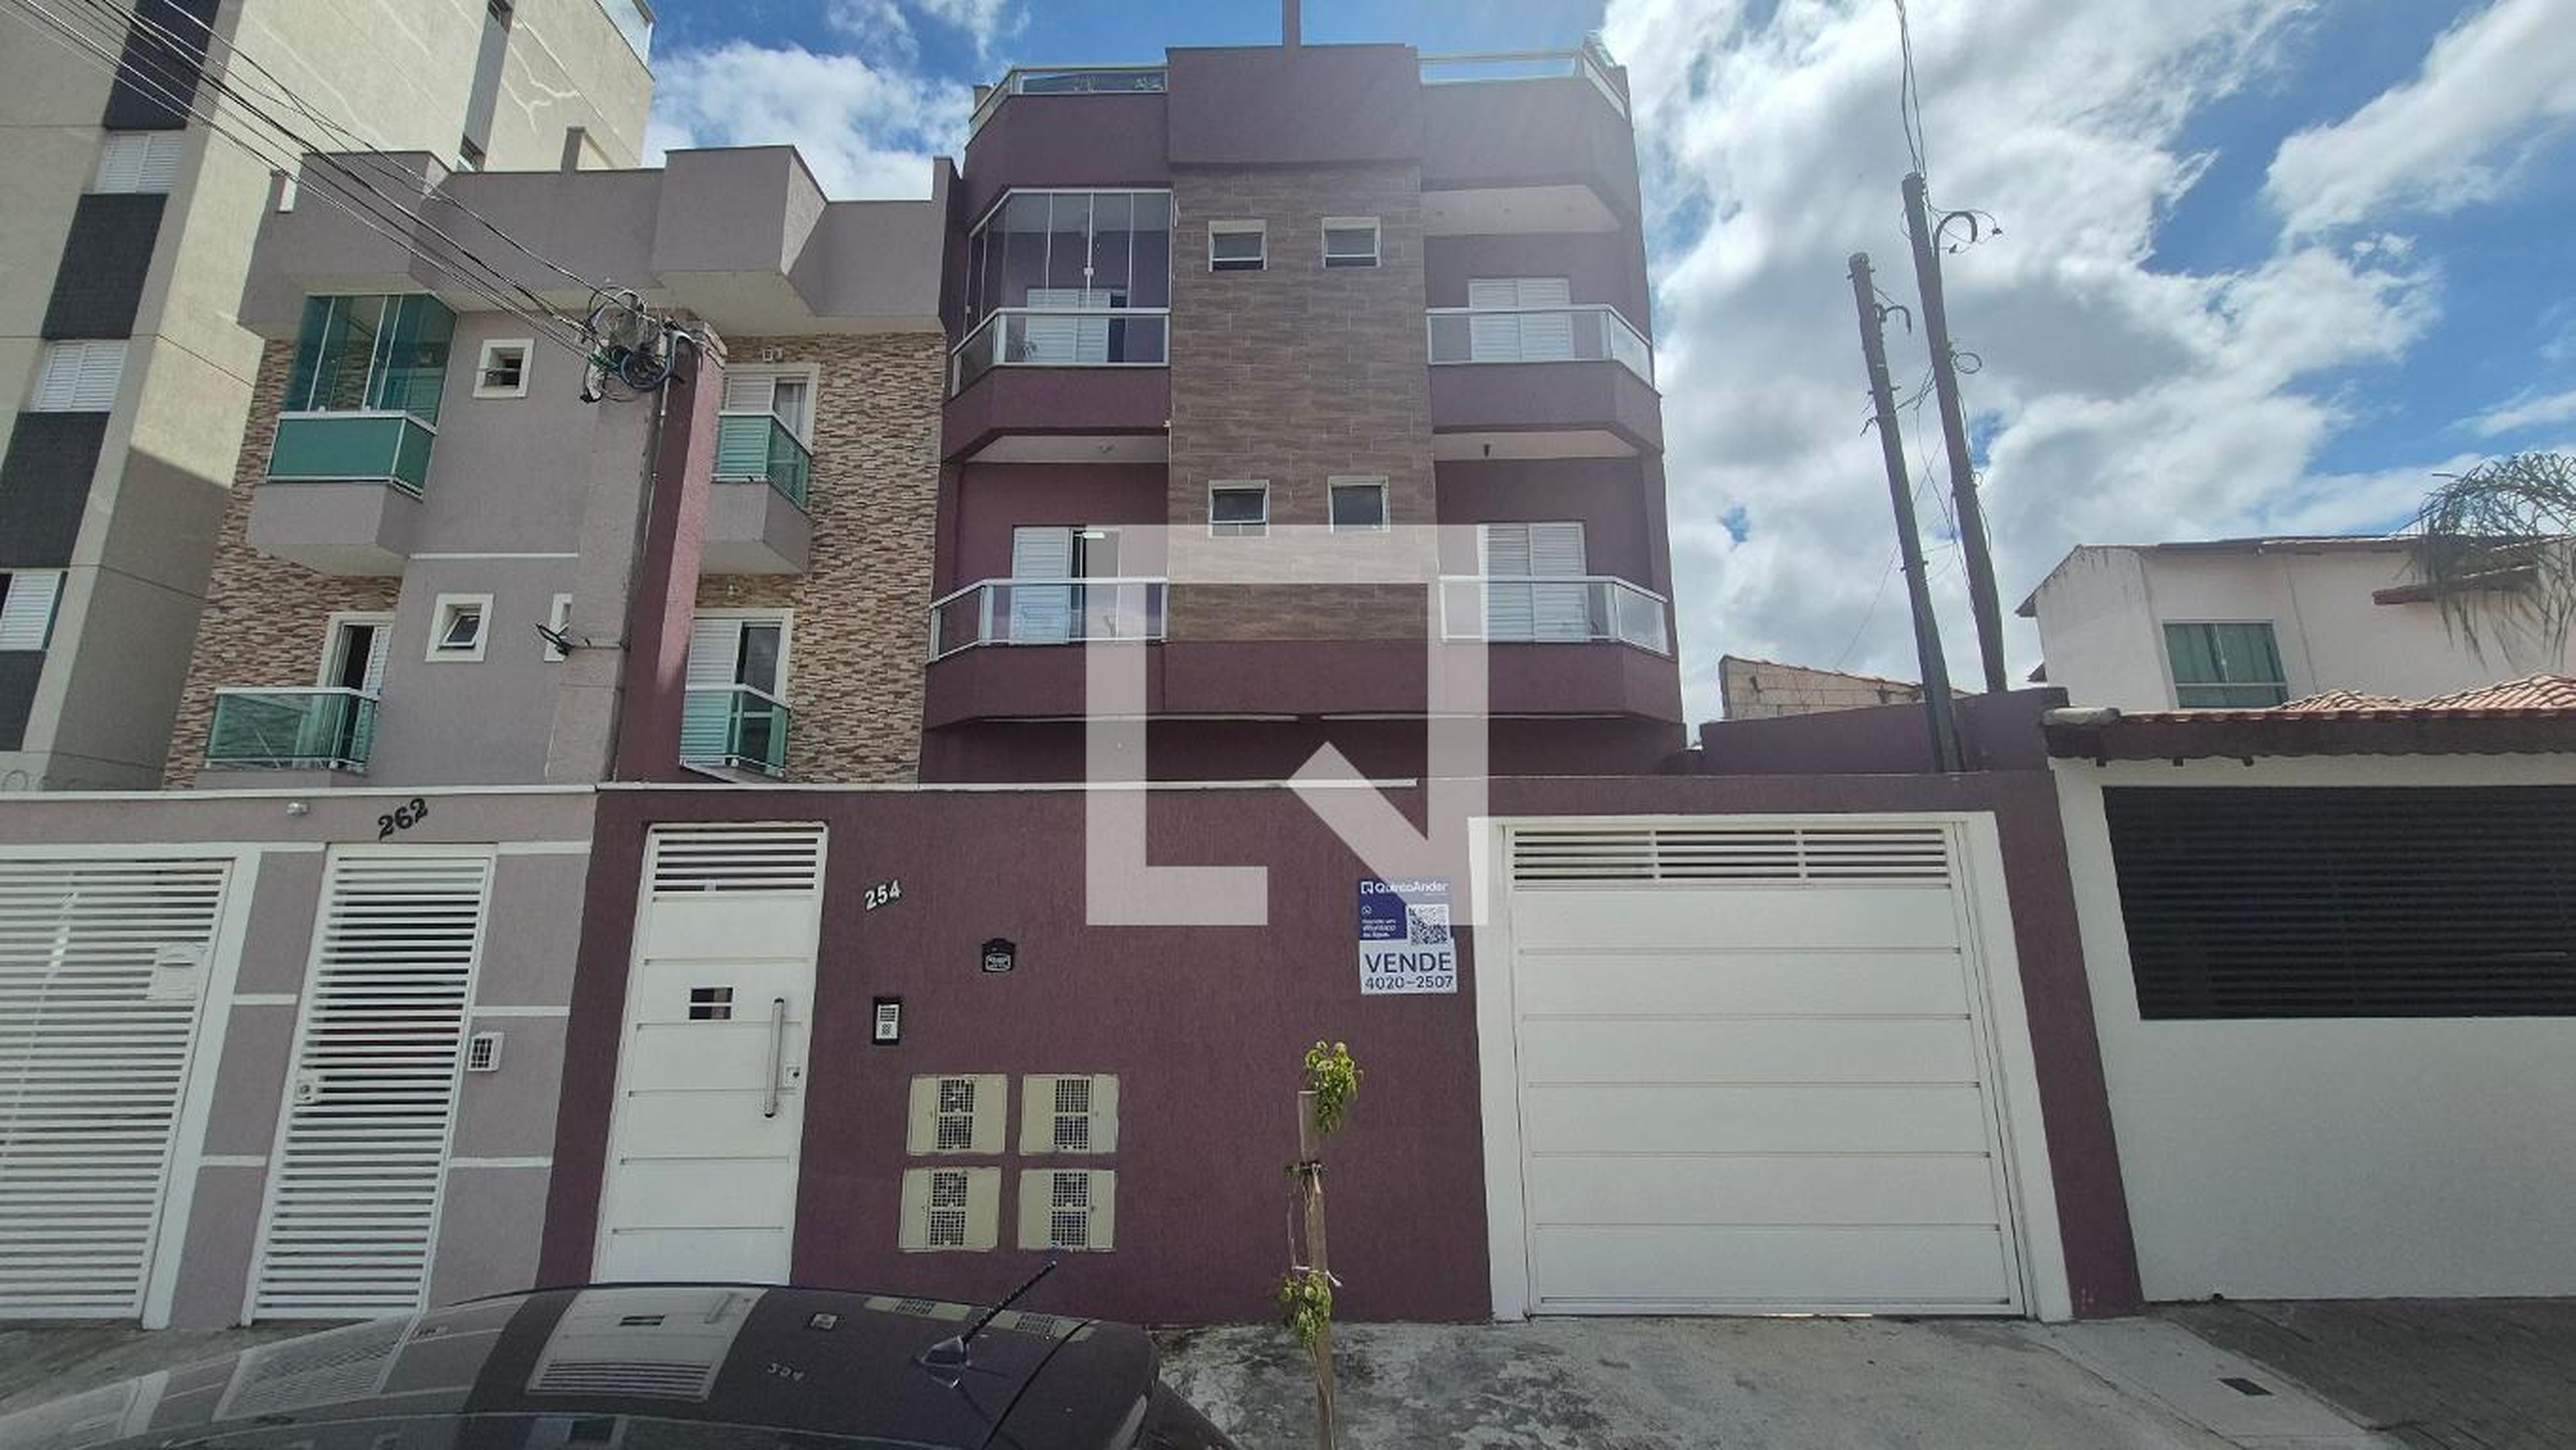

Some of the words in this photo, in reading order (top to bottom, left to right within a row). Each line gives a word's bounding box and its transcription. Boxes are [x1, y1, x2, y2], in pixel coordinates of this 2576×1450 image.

[378, 797, 428, 840] 262
[865, 879, 901, 910] 254
[1364, 952, 1451, 972] VENDE
[1365, 976, 1453, 989] 4020-2507
